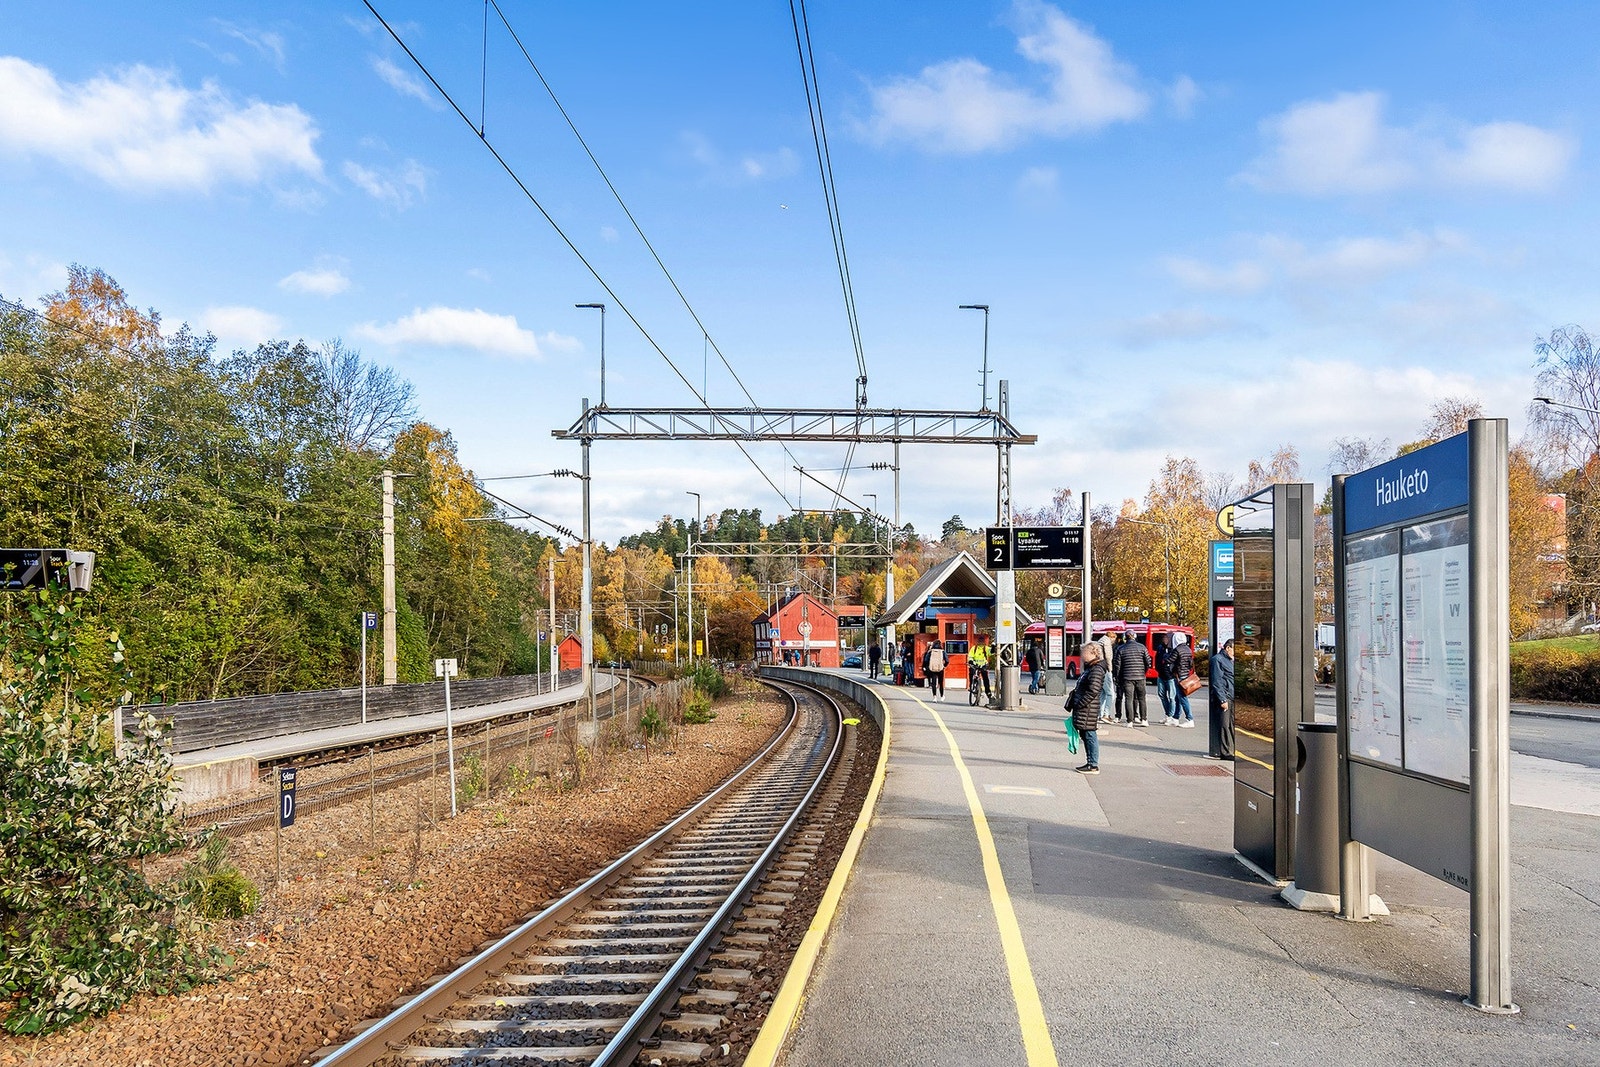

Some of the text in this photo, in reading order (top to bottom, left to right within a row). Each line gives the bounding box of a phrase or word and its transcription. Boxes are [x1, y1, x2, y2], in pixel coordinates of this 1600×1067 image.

[1376, 469, 1429, 507] Hauketo
[991, 533, 1004, 541] Spor
[1017, 537, 1042, 546] Lysaker
[993, 548, 1003, 562] 2
[54, 569, 61, 584] 1
[1052, 586, 1060, 595] D
[368, 619, 375, 627] D
[283, 794, 293, 819] D
